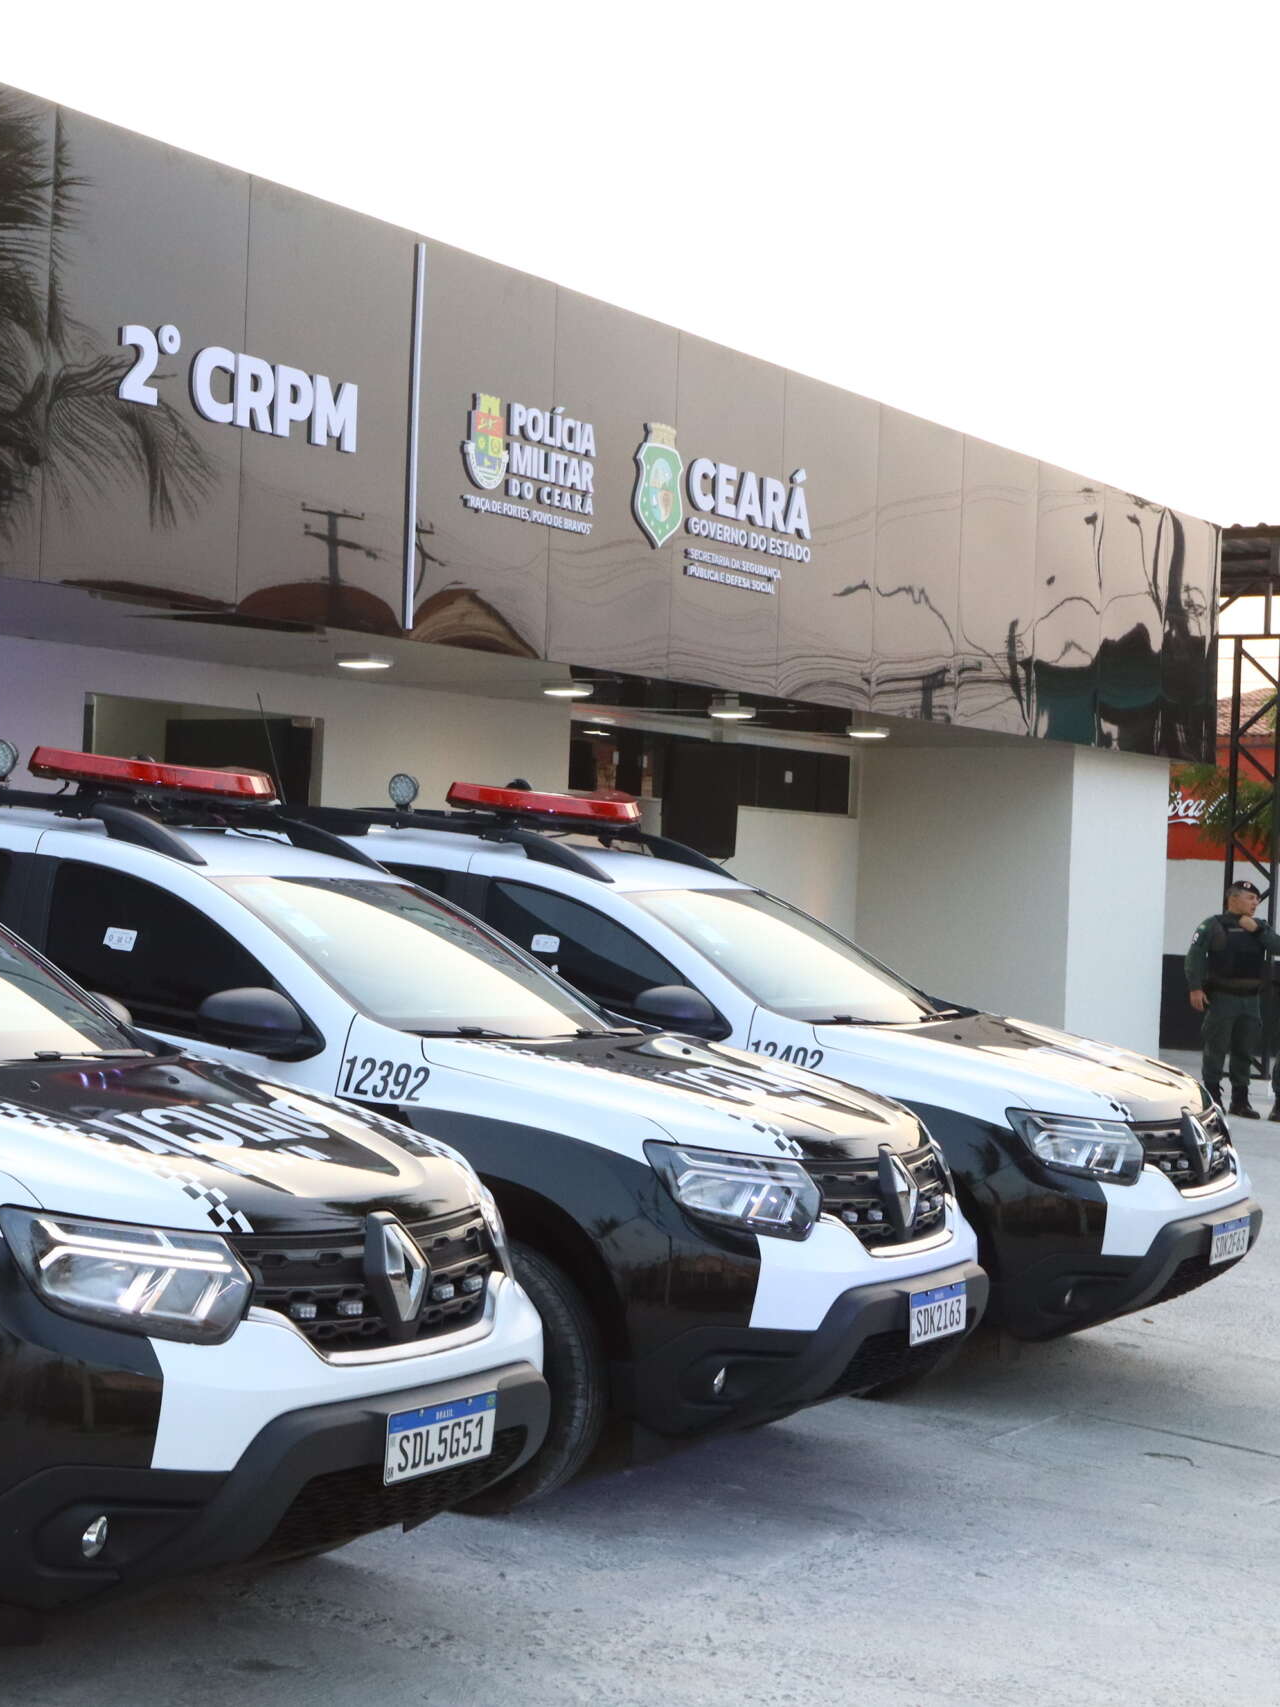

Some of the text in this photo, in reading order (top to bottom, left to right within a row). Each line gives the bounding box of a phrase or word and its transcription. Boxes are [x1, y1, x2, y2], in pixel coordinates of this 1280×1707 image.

[190, 346, 359, 453] CRPM
[508, 402, 596, 457] POLÍCIA
[507, 441, 595, 493] MILITAR
[491, 499, 502, 513] DE
[532, 510, 553, 526] POVO
[553, 516, 564, 528] DE
[506, 478, 593, 515] DO CEARÁ
[688, 457, 812, 540] CEARÁ
[688, 516, 812, 563] GOVERNO DO ESTADO
[725, 573, 751, 589] DEFESA
[751, 579, 776, 595] SOCIAL
[731, 558, 741, 569] DA
[741, 560, 782, 582] SEGURANÇA
[343, 1055, 431, 1102] 12392
[916, 1299, 962, 1338] SDK2I63
[397, 1416, 485, 1473] SDL5G51
